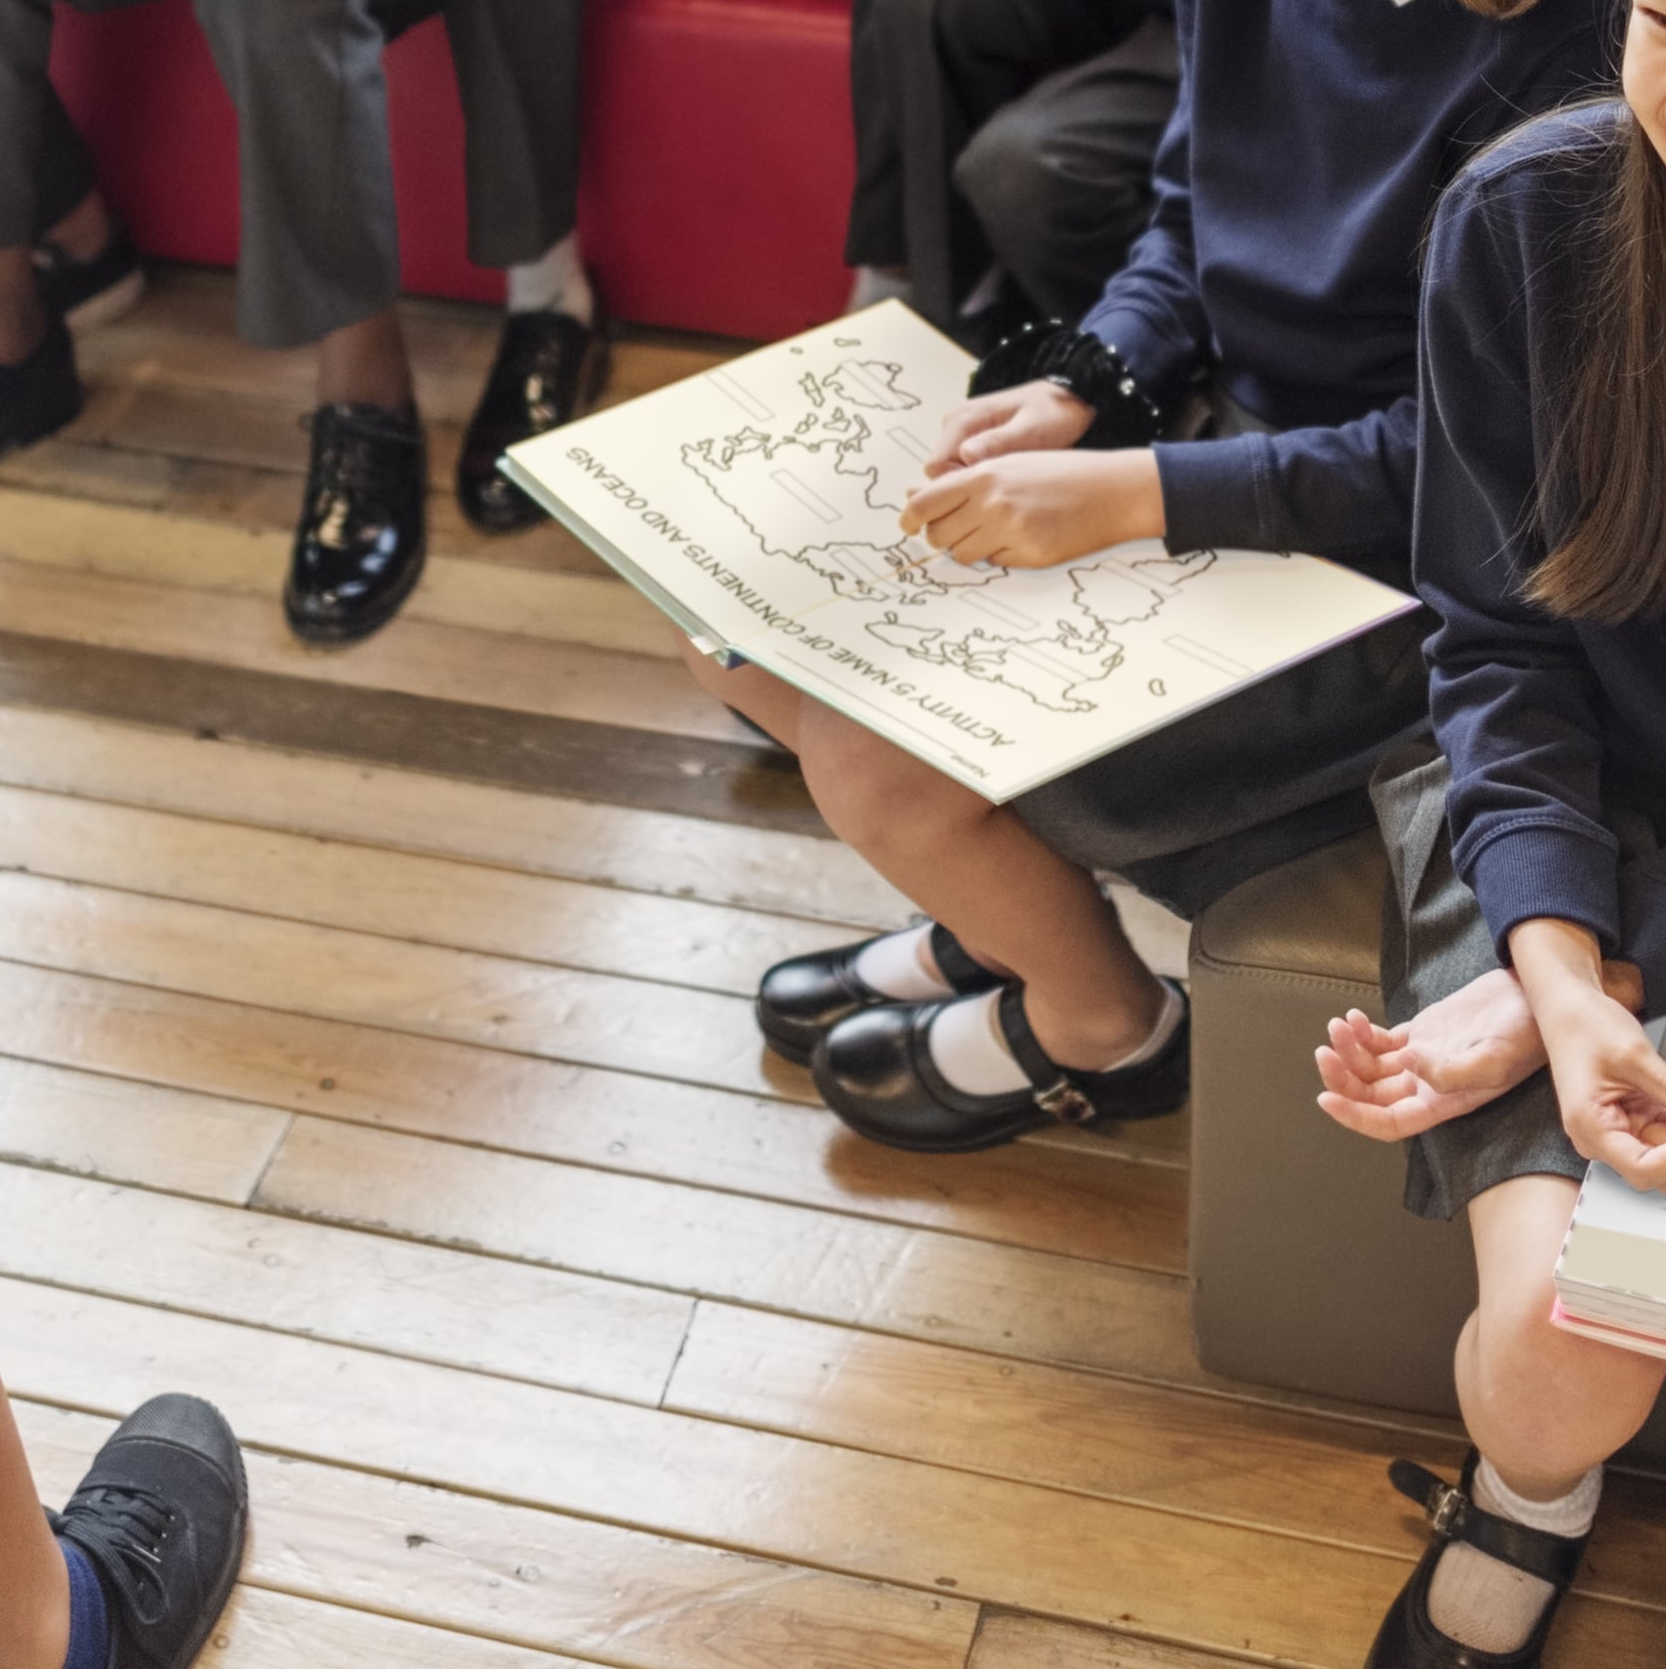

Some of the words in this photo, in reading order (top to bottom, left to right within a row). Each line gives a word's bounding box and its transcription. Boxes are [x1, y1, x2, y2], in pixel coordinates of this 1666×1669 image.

[565, 446, 648, 511] OCEANS
[640, 510, 691, 543] AND
[682, 542, 806, 635] CONTINENTS
[797, 634, 835, 652] OF
[831, 647, 899, 686] NAME
[907, 693, 1017, 748] ACTIVITY
